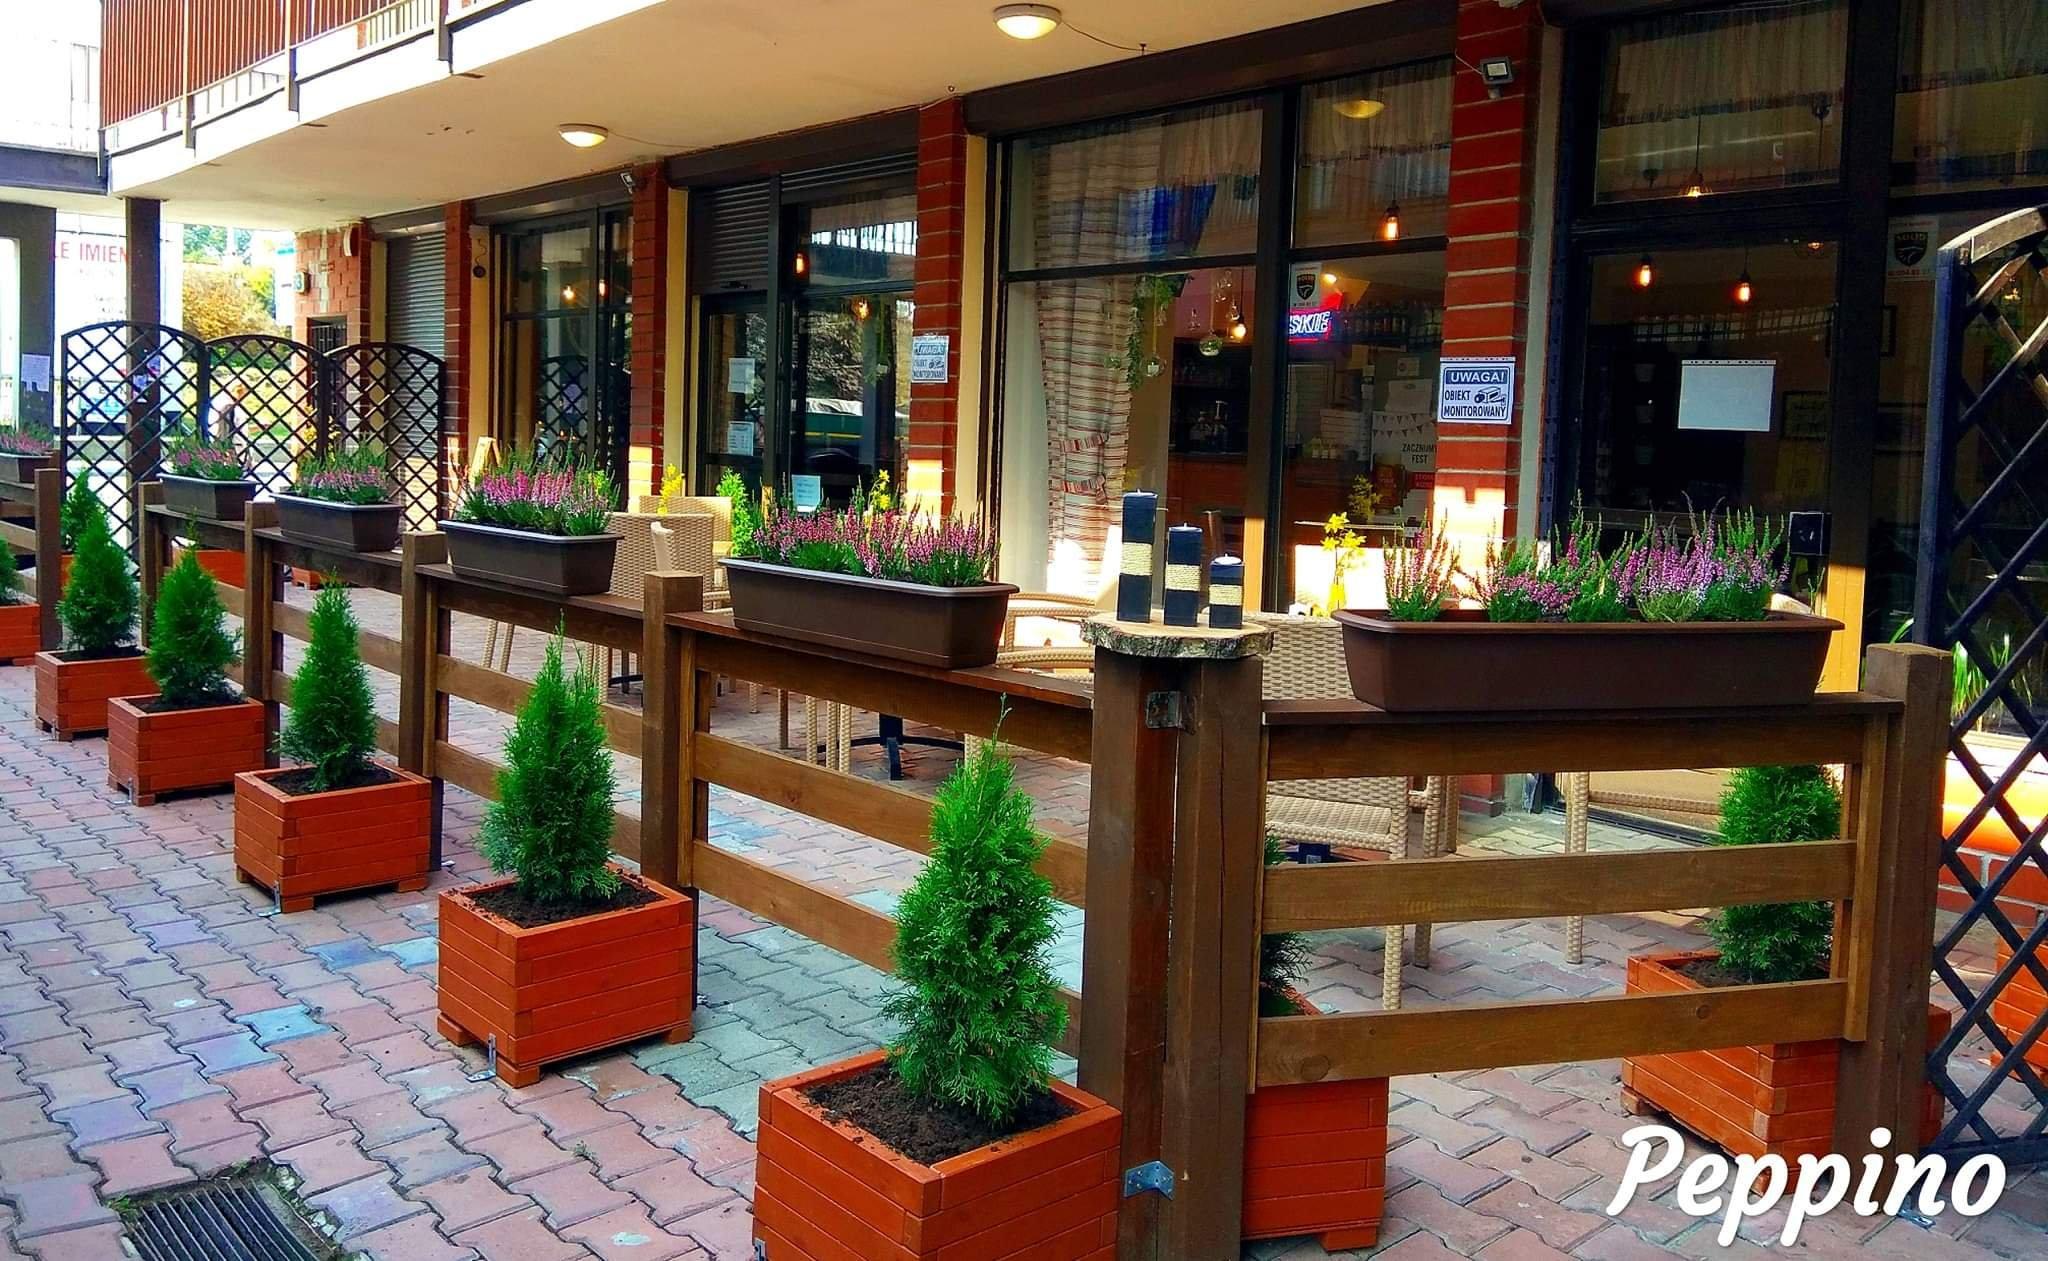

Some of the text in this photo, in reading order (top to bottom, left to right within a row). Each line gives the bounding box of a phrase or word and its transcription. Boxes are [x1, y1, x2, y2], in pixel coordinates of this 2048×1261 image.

[1289, 311, 1330, 334] SKIE
[1450, 371, 1505, 382] UWAGA!
[1444, 390, 1471, 401] OBIEKT
[1443, 405, 1506, 417] MONITOROWANY
[1412, 454, 1428, 464] FEST
